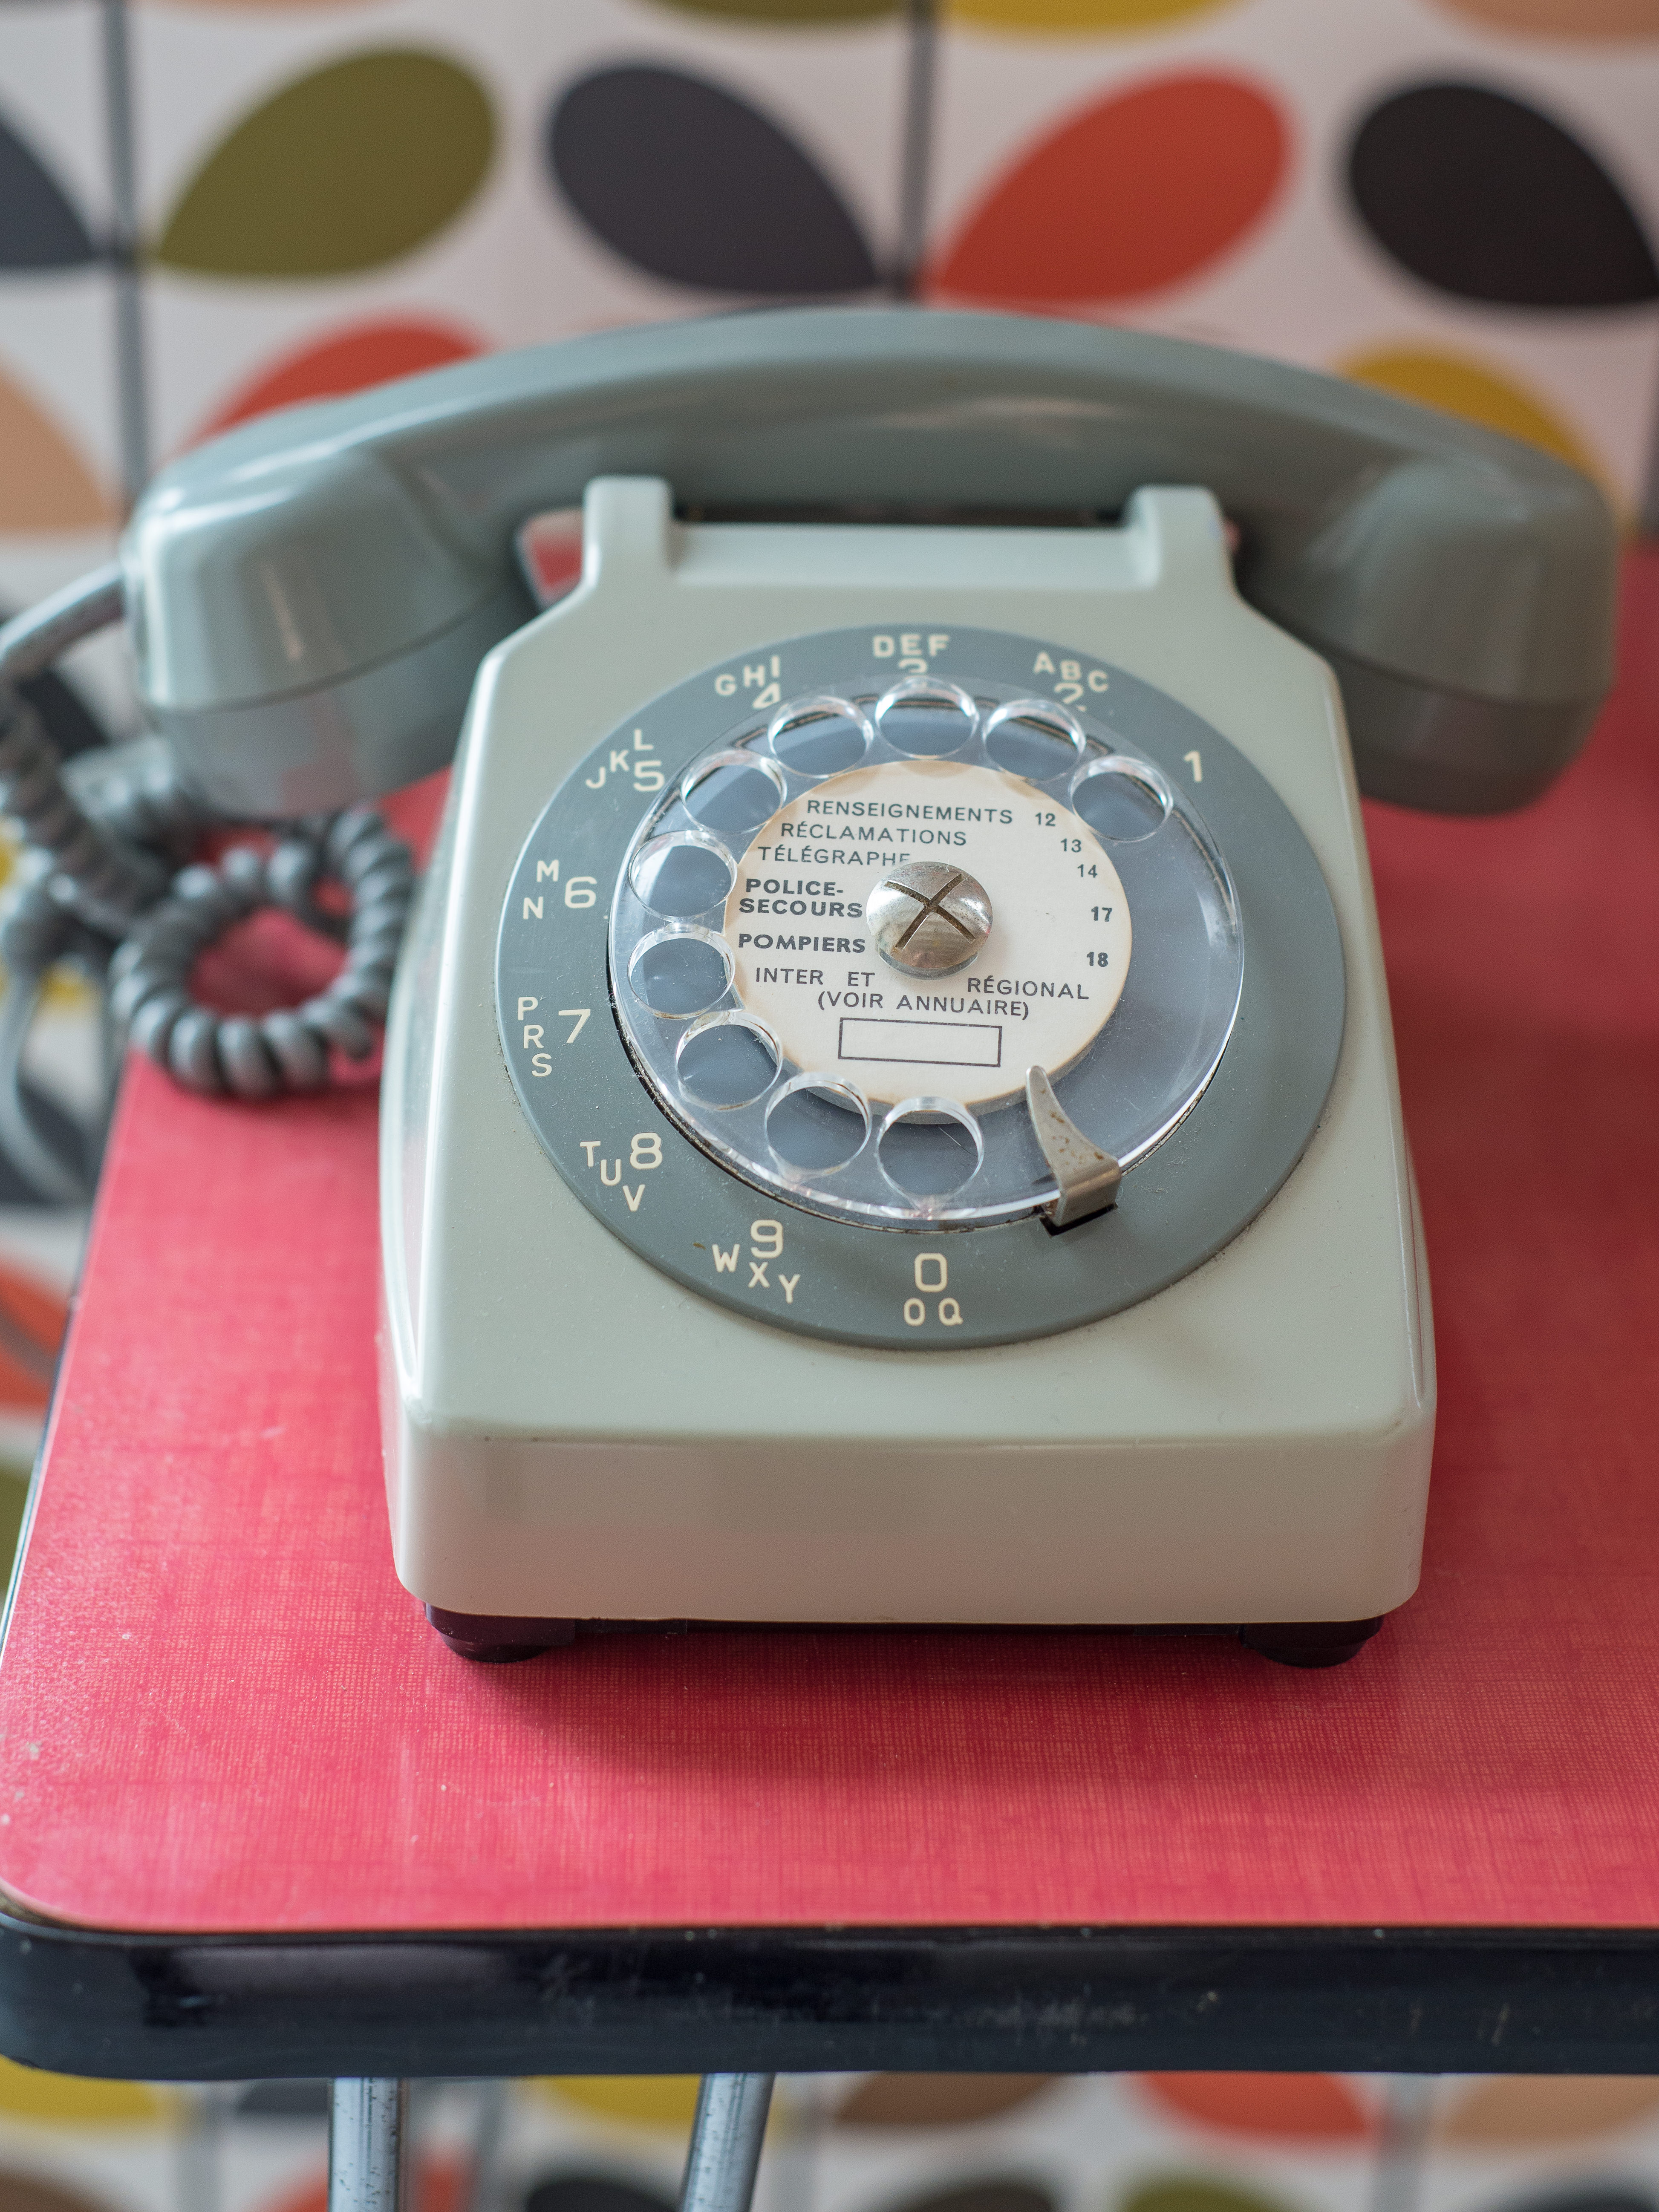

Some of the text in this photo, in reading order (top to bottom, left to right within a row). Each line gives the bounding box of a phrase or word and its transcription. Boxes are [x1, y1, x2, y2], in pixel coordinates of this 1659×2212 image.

[874, 633, 949, 658] DEF
[715, 655, 780, 696] GHI
[1033, 652, 1108, 692] ABC
[752, 683, 780, 709] 4
[633, 761, 665, 791] 5
[1183, 751, 1203, 782] 1
[807, 800, 1056, 826] RENSEIGNEMENTS 12
[781, 821, 1082, 853] RÉCLAMATIONS 13
[1077, 864, 1097, 878] 14
[565, 877, 597, 908] 6
[746, 878, 843, 896] POLICE-
[739, 898, 1112, 922] SECOURS 17
[739, 933, 1108, 967] POMPIERS 18
[756, 967, 1089, 1000] INTER ET RÉGIONAL
[818, 991, 1029, 1020] (VOIR ANNUAIRE)
[558, 1008, 591, 1044] 7
[630, 1132, 663, 1169] 8
[750, 1219, 784, 1258] 9
[914, 1253, 947, 1292] 0
